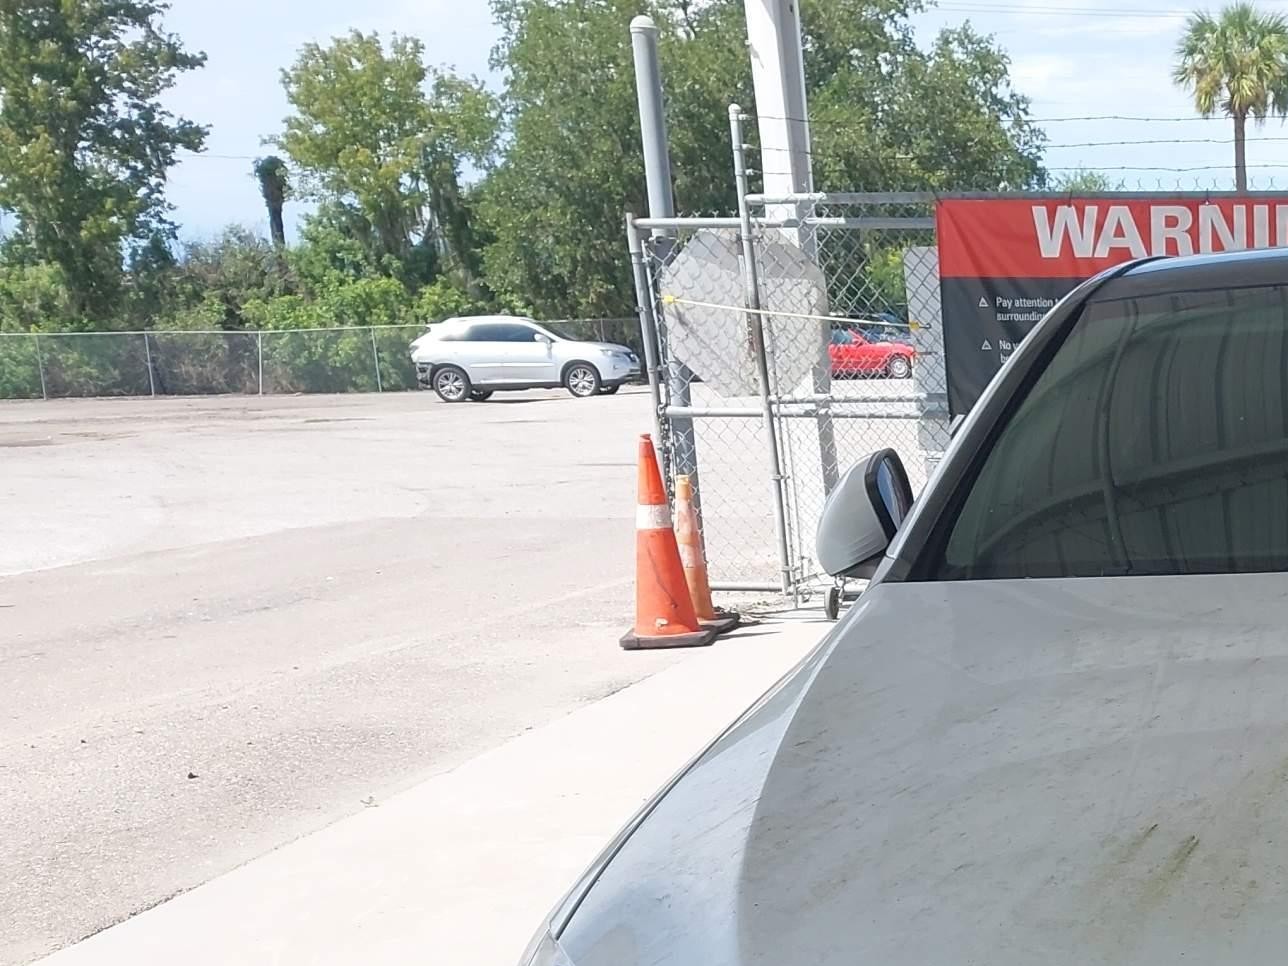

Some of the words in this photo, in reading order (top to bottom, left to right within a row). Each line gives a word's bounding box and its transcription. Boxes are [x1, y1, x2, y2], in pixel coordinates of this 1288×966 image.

[996, 296, 1012, 309] Pay
[1014, 297, 1054, 308] attention
[997, 311, 1045, 321] surroundin
[999, 340, 1011, 350] No
